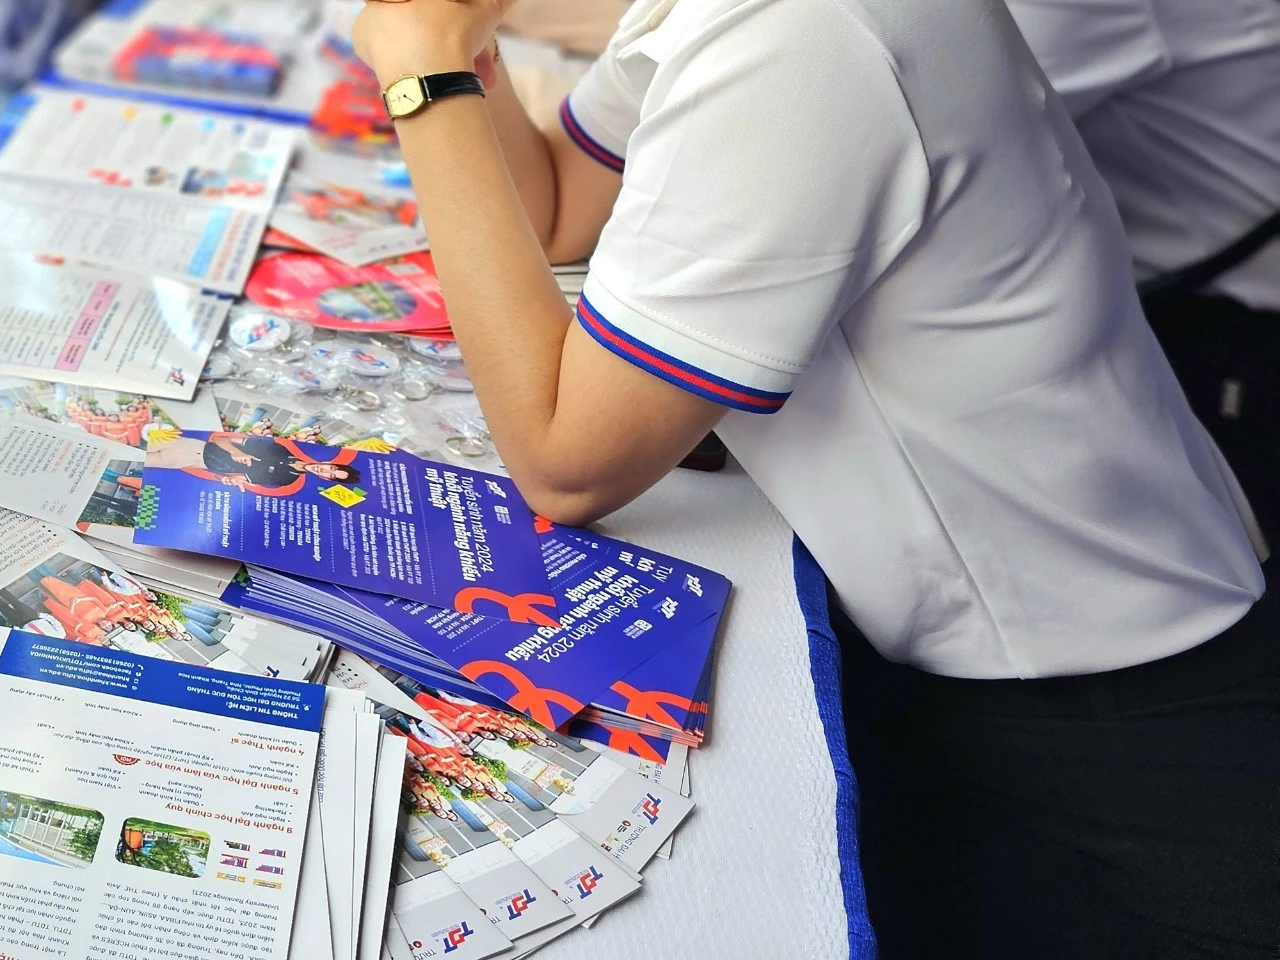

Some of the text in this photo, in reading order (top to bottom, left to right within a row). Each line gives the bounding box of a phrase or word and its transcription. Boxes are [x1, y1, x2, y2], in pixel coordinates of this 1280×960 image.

[424, 468, 447, 510] mỹ thuật
[443, 471, 482, 582] khối ngành năng khiếu
[460, 476, 494, 572] Tuyển sinh năm 2024
[564, 566, 619, 602] mỹ thuật
[604, 574, 639, 597] khối
[569, 591, 612, 618] ngành
[536, 584, 655, 663] Tuyển sinh năm 2024
[504, 634, 548, 661] khiếu
[186, 686, 210, 694] THẮNG
[211, 690, 226, 698] ĐỨC
[226, 701, 239, 709] HỆ:
[239, 704, 257, 712] LIÊN
[270, 700, 300, 710] TRƯỜNG
[272, 710, 298, 719] THÔNG
[241, 740, 264, 750] Thạc
[266, 744, 296, 754] ngành
[145, 760, 163, 769] học
[164, 764, 181, 772] vừa
[184, 768, 201, 777] làm
[203, 772, 220, 780] vừa
[222, 775, 240, 784] học
[242, 778, 258, 788] Đại
[260, 783, 290, 792] ngành
[165, 802, 183, 812] quy
[185, 808, 212, 818] chính
[214, 814, 233, 823] học
[234, 817, 250, 826] Đại
[253, 821, 284, 831] ngành
